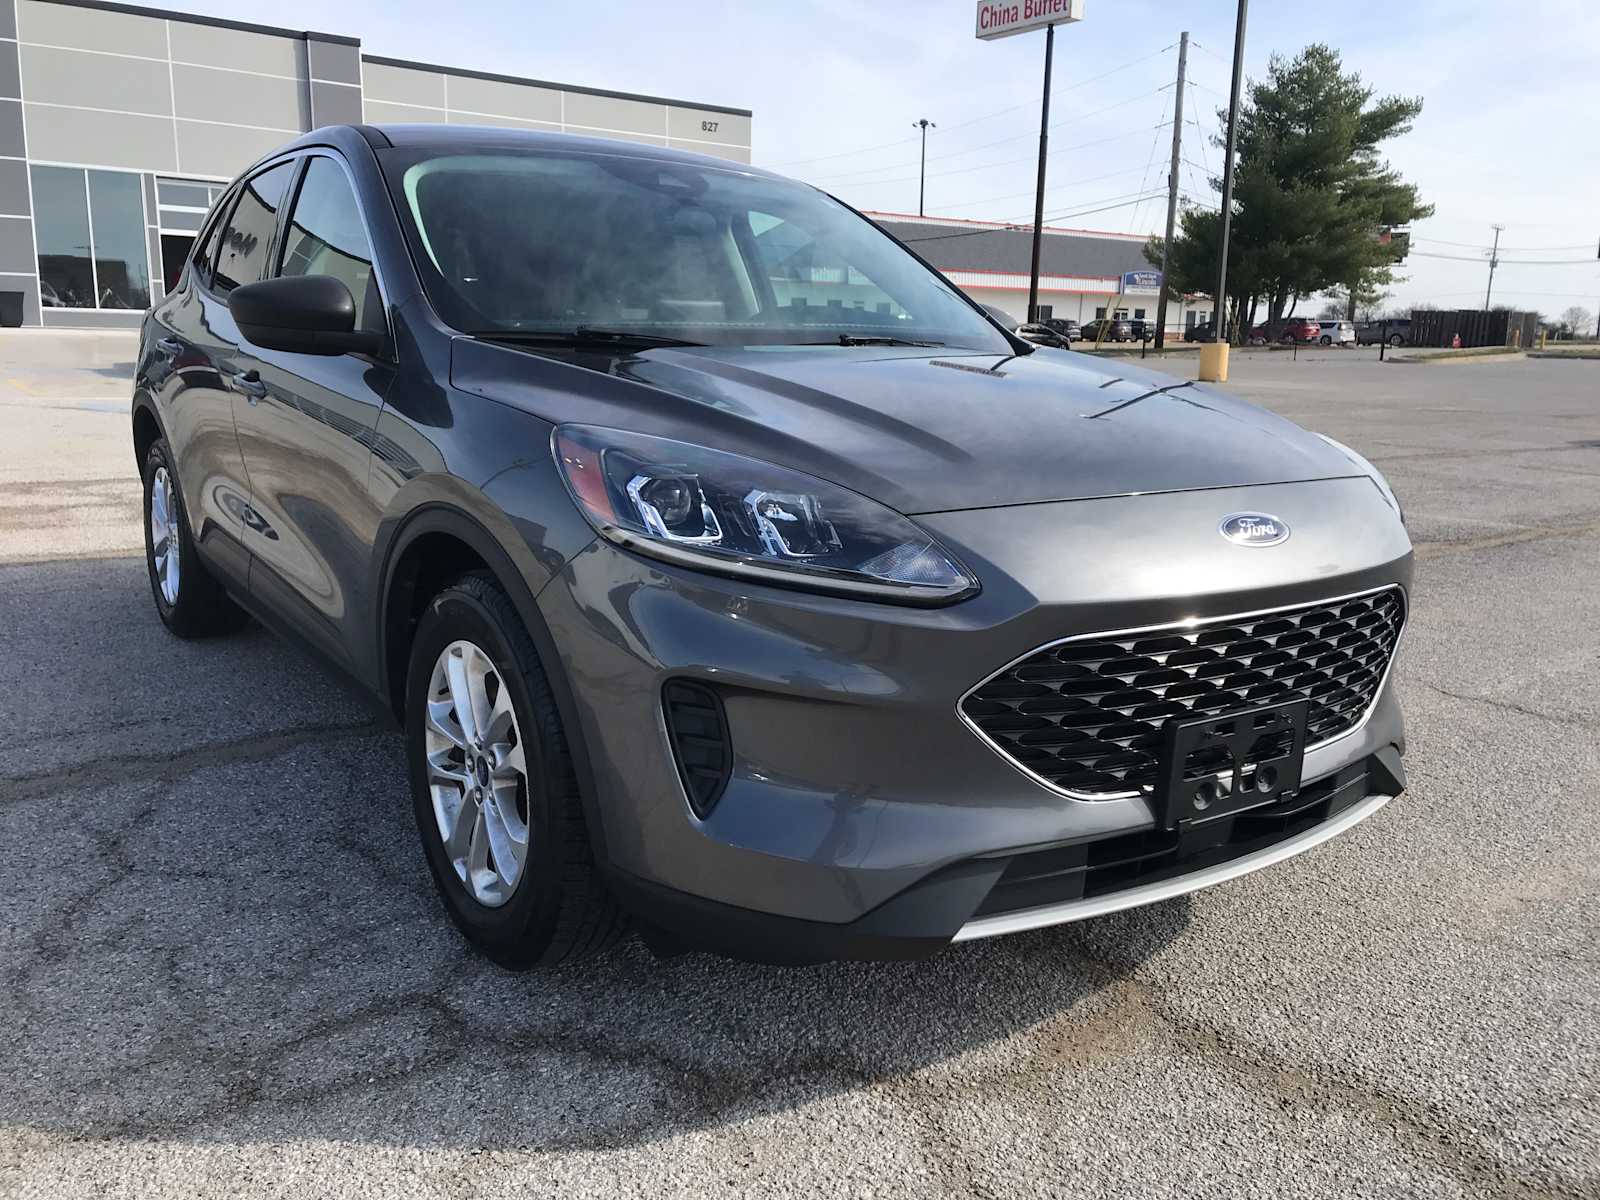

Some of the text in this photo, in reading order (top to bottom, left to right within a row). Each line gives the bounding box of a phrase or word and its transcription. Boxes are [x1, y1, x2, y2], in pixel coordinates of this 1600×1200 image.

[980, 3, 1019, 29] China
[701, 120, 719, 133] 827
[1237, 517, 1278, 537] Ford
